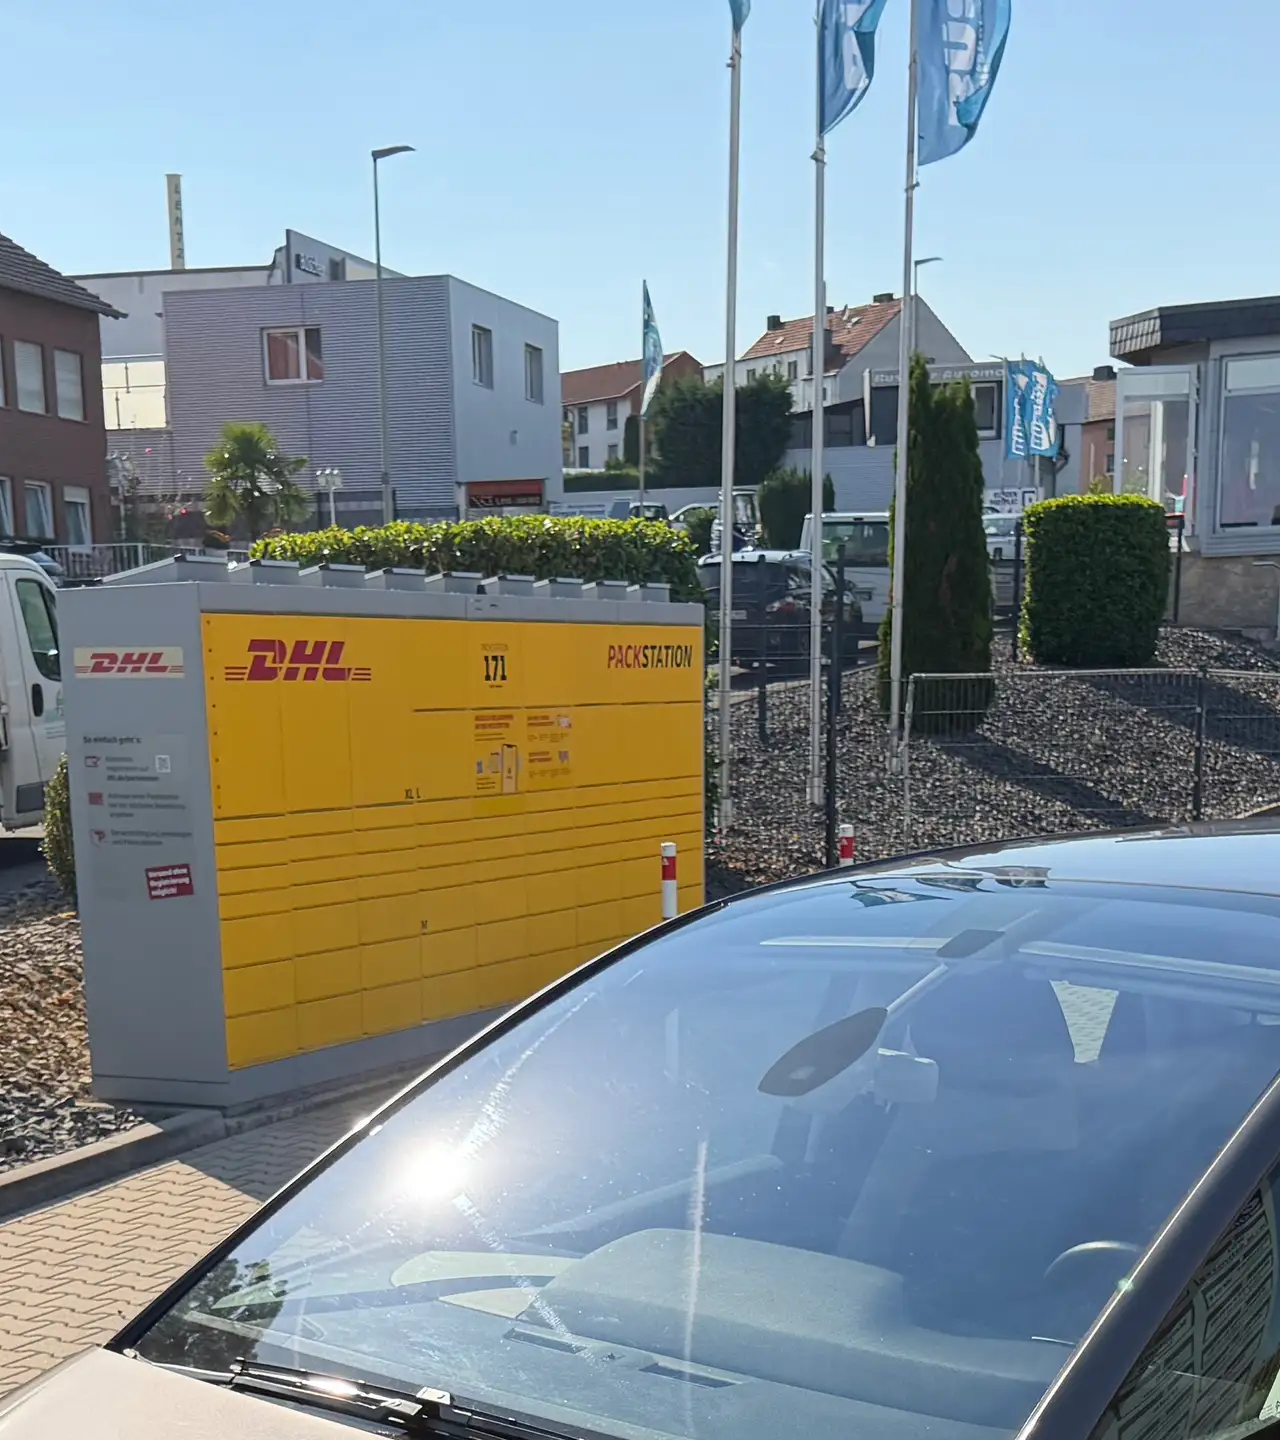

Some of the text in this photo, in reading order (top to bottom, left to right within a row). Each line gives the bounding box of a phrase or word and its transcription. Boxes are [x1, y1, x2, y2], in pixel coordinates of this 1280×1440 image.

[90, 652, 172, 673] DHL
[247, 638, 353, 681] DHL
[483, 655, 508, 681] 171
[607, 644, 693, 669] PACKSTATION
